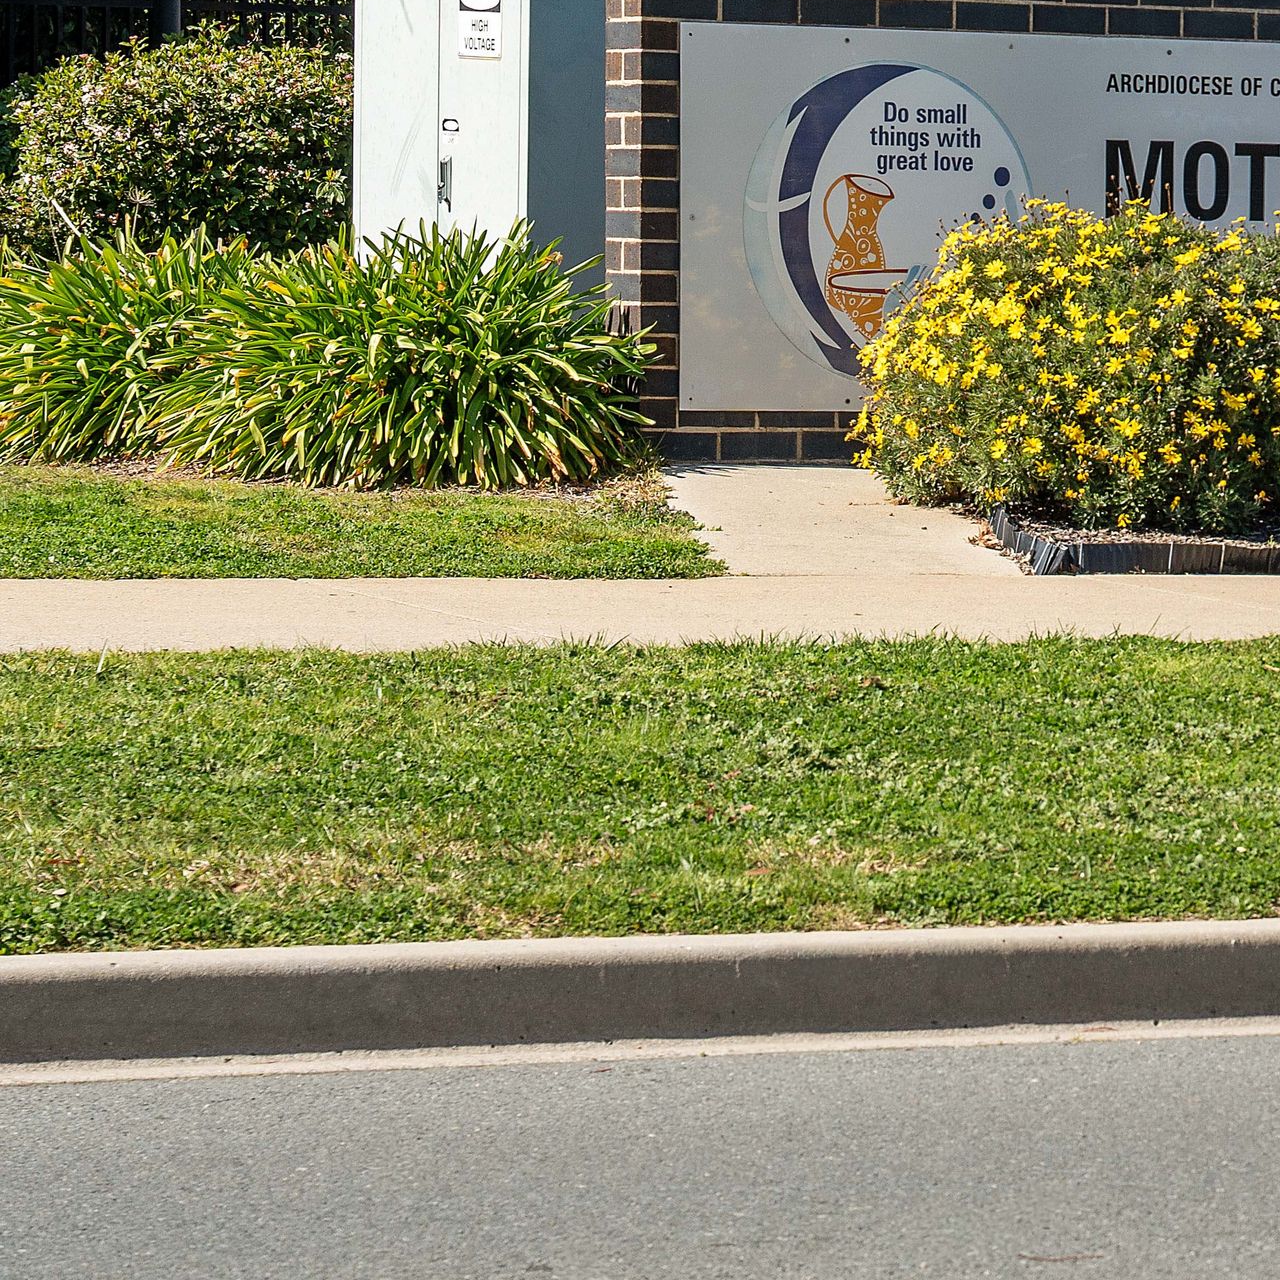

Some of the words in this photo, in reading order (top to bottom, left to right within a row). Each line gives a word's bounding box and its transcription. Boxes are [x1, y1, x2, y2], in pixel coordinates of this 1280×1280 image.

[471, 19, 489, 32] HIGH
[464, 37, 496, 51] VOLTAGE
[1106, 73, 1233, 96] ARCHDIOCESE
[1240, 77, 1263, 97] OF
[883, 101, 909, 123] Do
[916, 103, 967, 125] small
[870, 125, 930, 152] things
[936, 127, 981, 149] with
[877, 152, 928, 175] great
[934, 150, 974, 172] love
